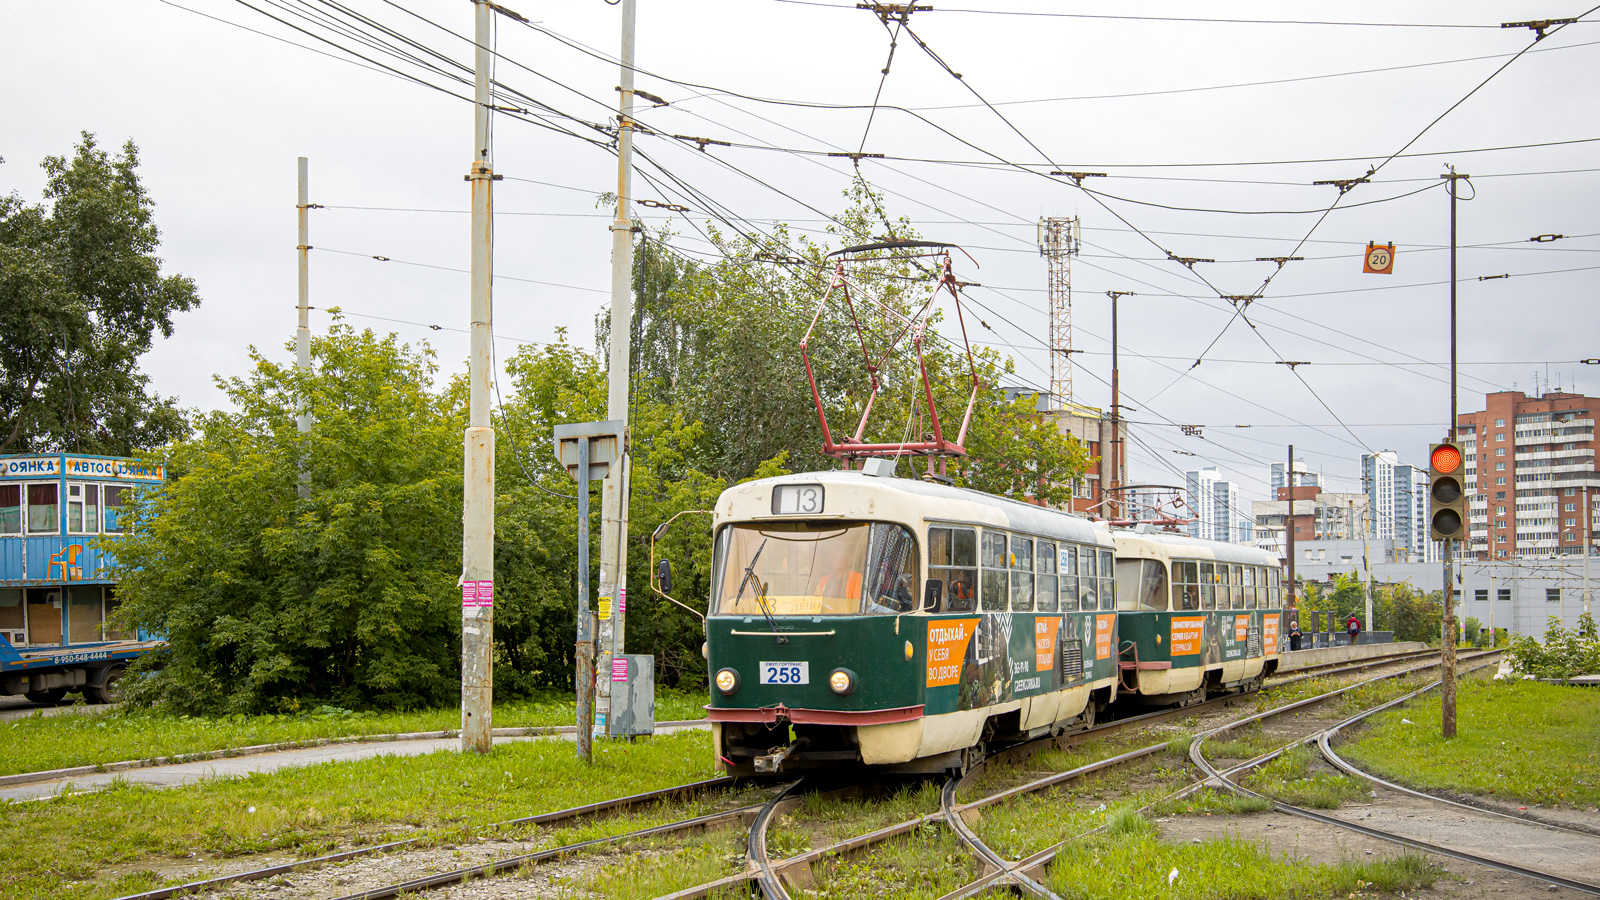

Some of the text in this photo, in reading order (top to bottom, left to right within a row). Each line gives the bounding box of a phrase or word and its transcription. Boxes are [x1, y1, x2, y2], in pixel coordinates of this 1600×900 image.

[1372, 255, 1386, 265] 20
[0, 461, 54, 472] ОЯНКА
[796, 489, 817, 512] 13
[930, 623, 964, 645] ОТДЫХАЙ
[55, 651, 107, 664] 8-950-548-4444
[929, 648, 949, 662] У СЕБЯ
[767, 667, 801, 683] 258
[929, 665, 958, 682] ВО ДВОРЕ
